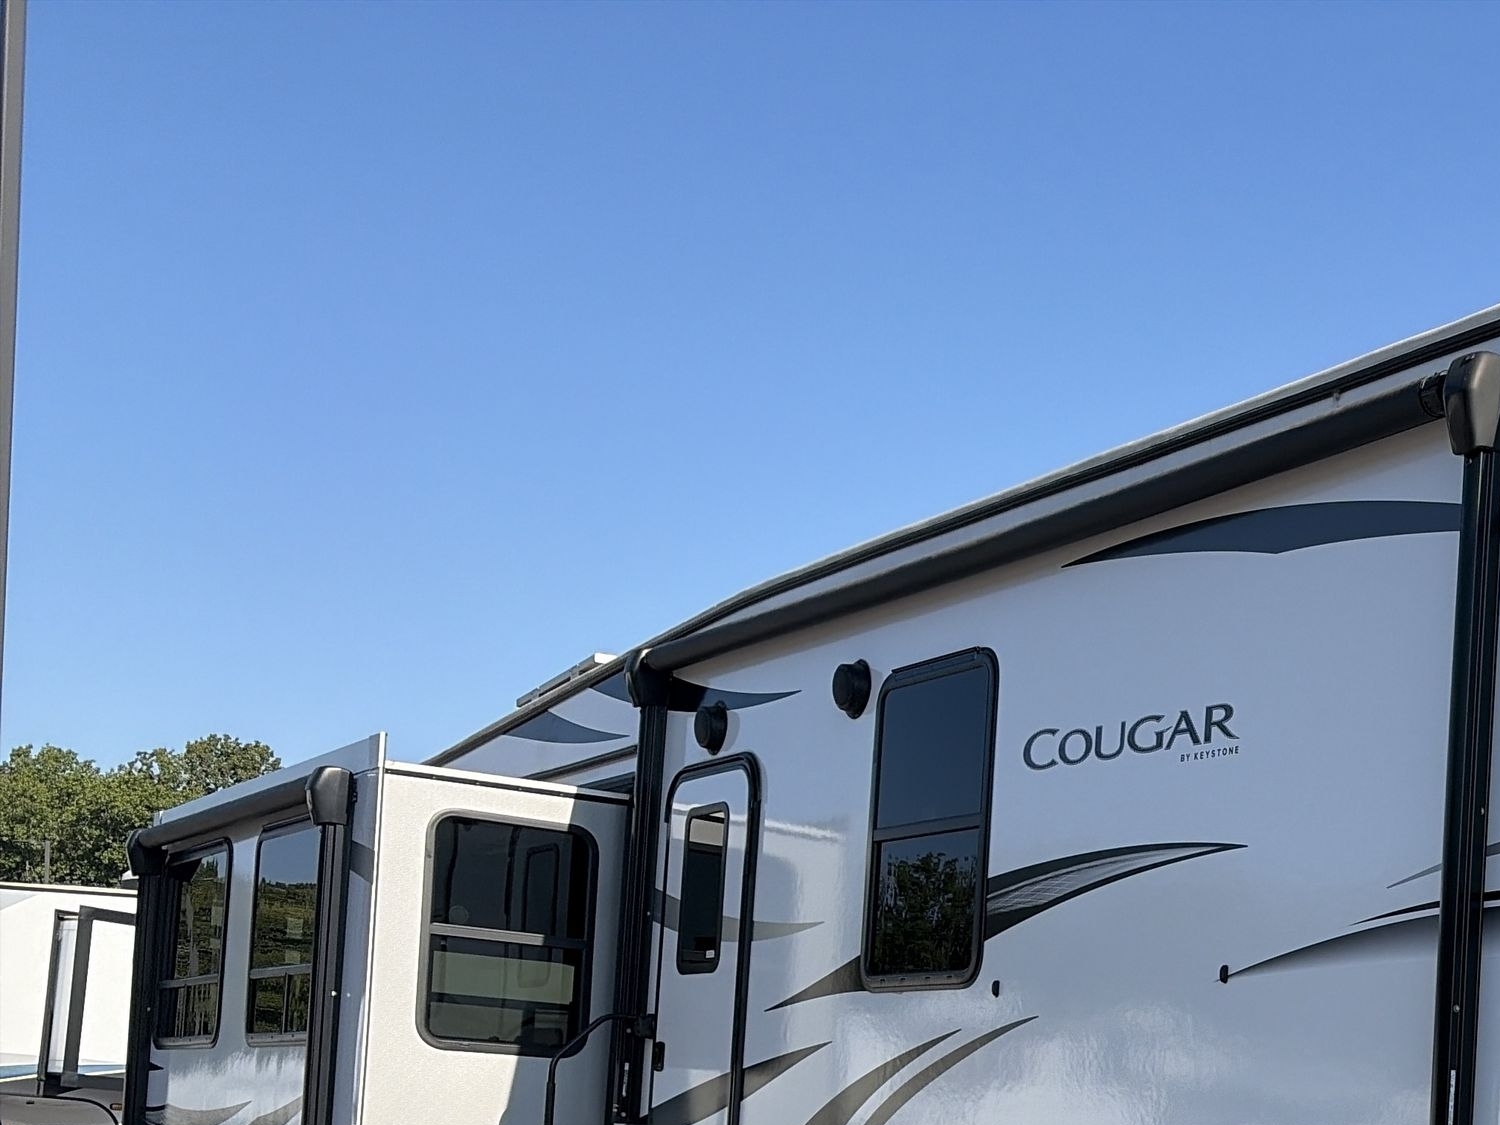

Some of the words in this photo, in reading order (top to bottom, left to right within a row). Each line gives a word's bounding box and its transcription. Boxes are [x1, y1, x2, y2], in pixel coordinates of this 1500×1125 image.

[1022, 702, 1240, 771] COUGAR
[1180, 753, 1190, 762] BY
[1193, 745, 1239, 760] KEYSTONE
